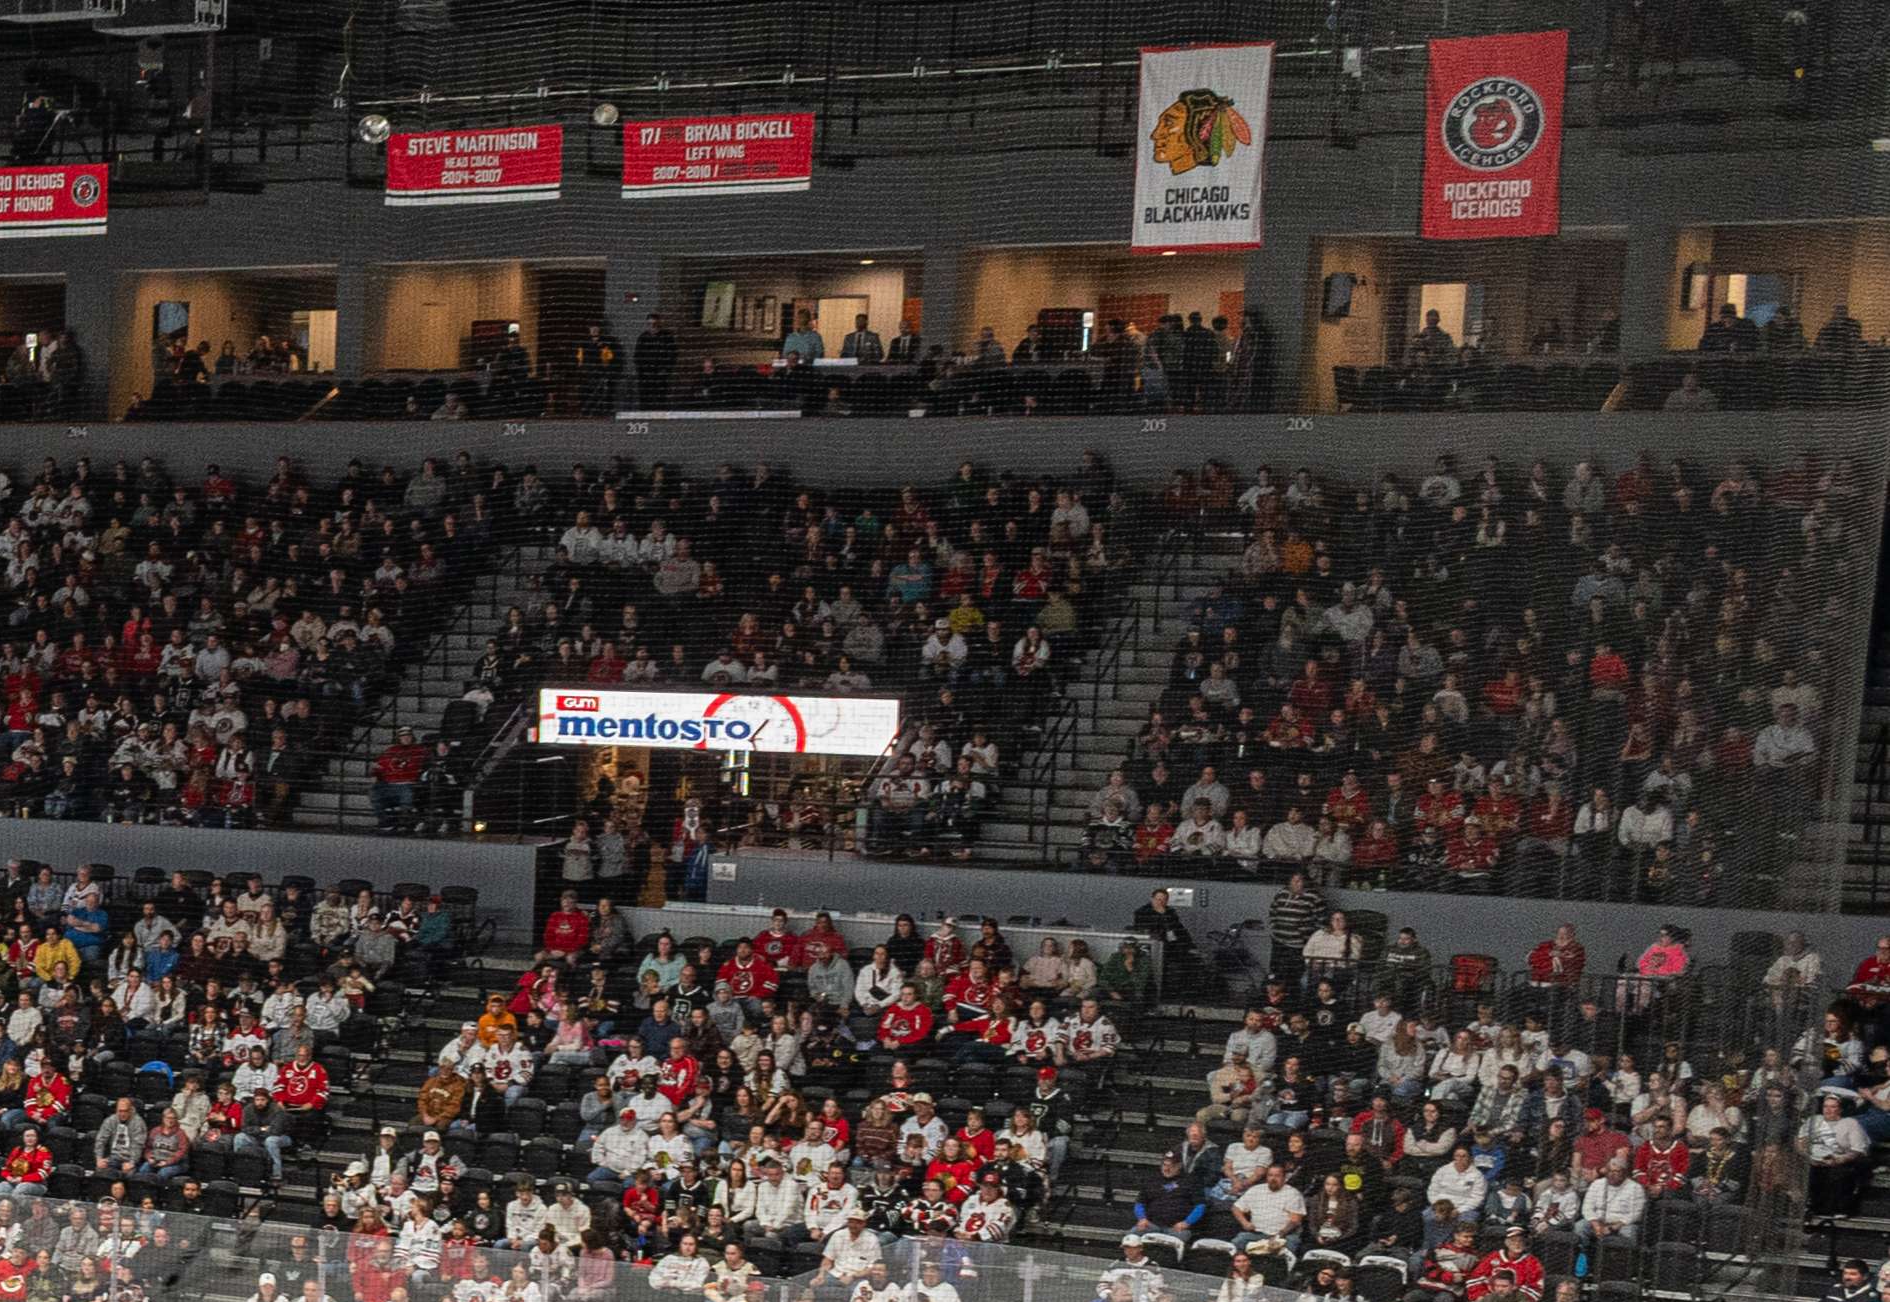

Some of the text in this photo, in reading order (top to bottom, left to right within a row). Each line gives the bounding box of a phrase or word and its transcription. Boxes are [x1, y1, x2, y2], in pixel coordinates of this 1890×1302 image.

[685, 124, 733, 142] BRYAN
[737, 121, 793, 139] BICKELL
[409, 133, 538, 155] STEVE MARTINSON
[16, 173, 65, 191] ICEHOGS
[1444, 180, 1531, 200] ROCKFORD
[13, 195, 54, 212] HONOR
[1165, 186, 1230, 205] CHICAGO
[1144, 203, 1250, 224] BLACKHAWKS
[1452, 198, 1522, 219] ICEHOGS
[558, 713, 702, 741] mentos
